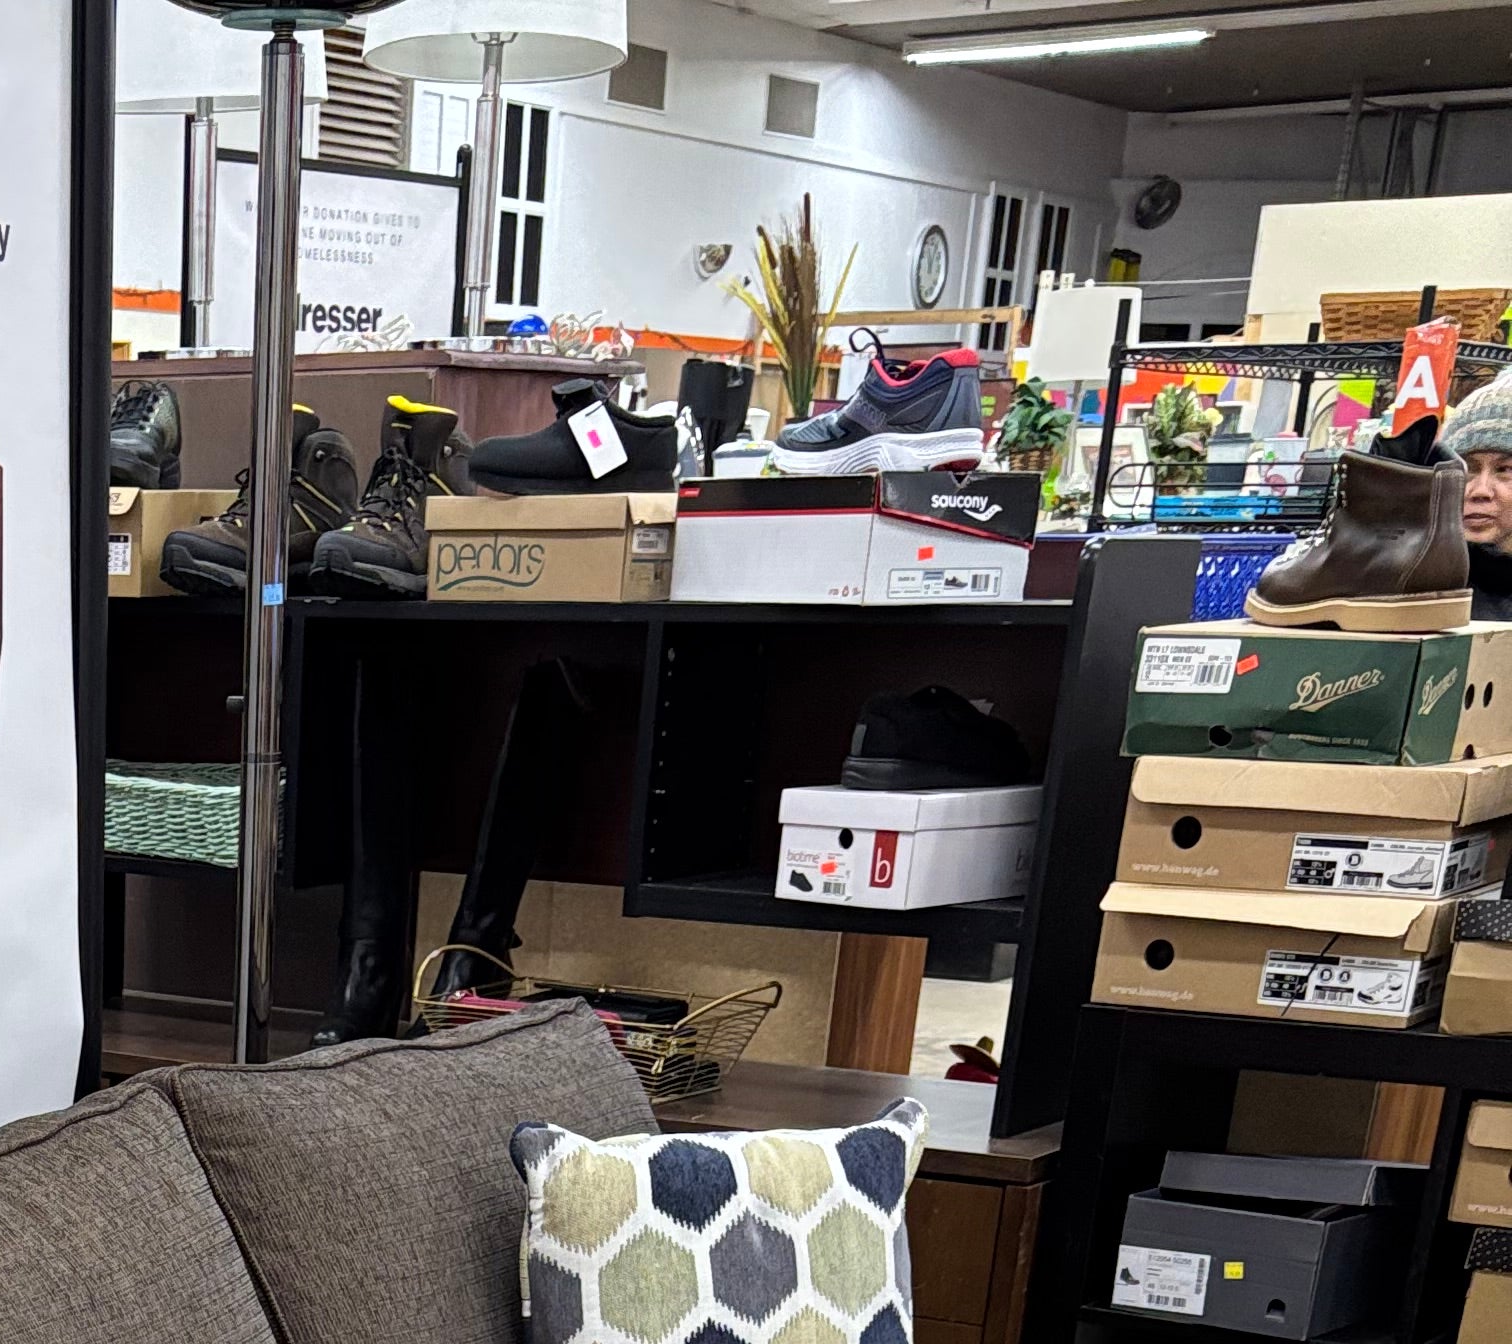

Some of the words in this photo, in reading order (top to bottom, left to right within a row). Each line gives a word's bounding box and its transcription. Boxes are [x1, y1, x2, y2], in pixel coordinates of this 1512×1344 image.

[313, 206, 369, 223] DONATION
[319, 228, 362, 243] MOVING
[365, 231, 386, 245] OUT
[1395, 355, 1440, 409] A
[931, 494, 988, 512] saucony
[436, 533, 545, 584] pedors
[1289, 668, 1384, 713] Danner
[874, 848, 891, 883] b
